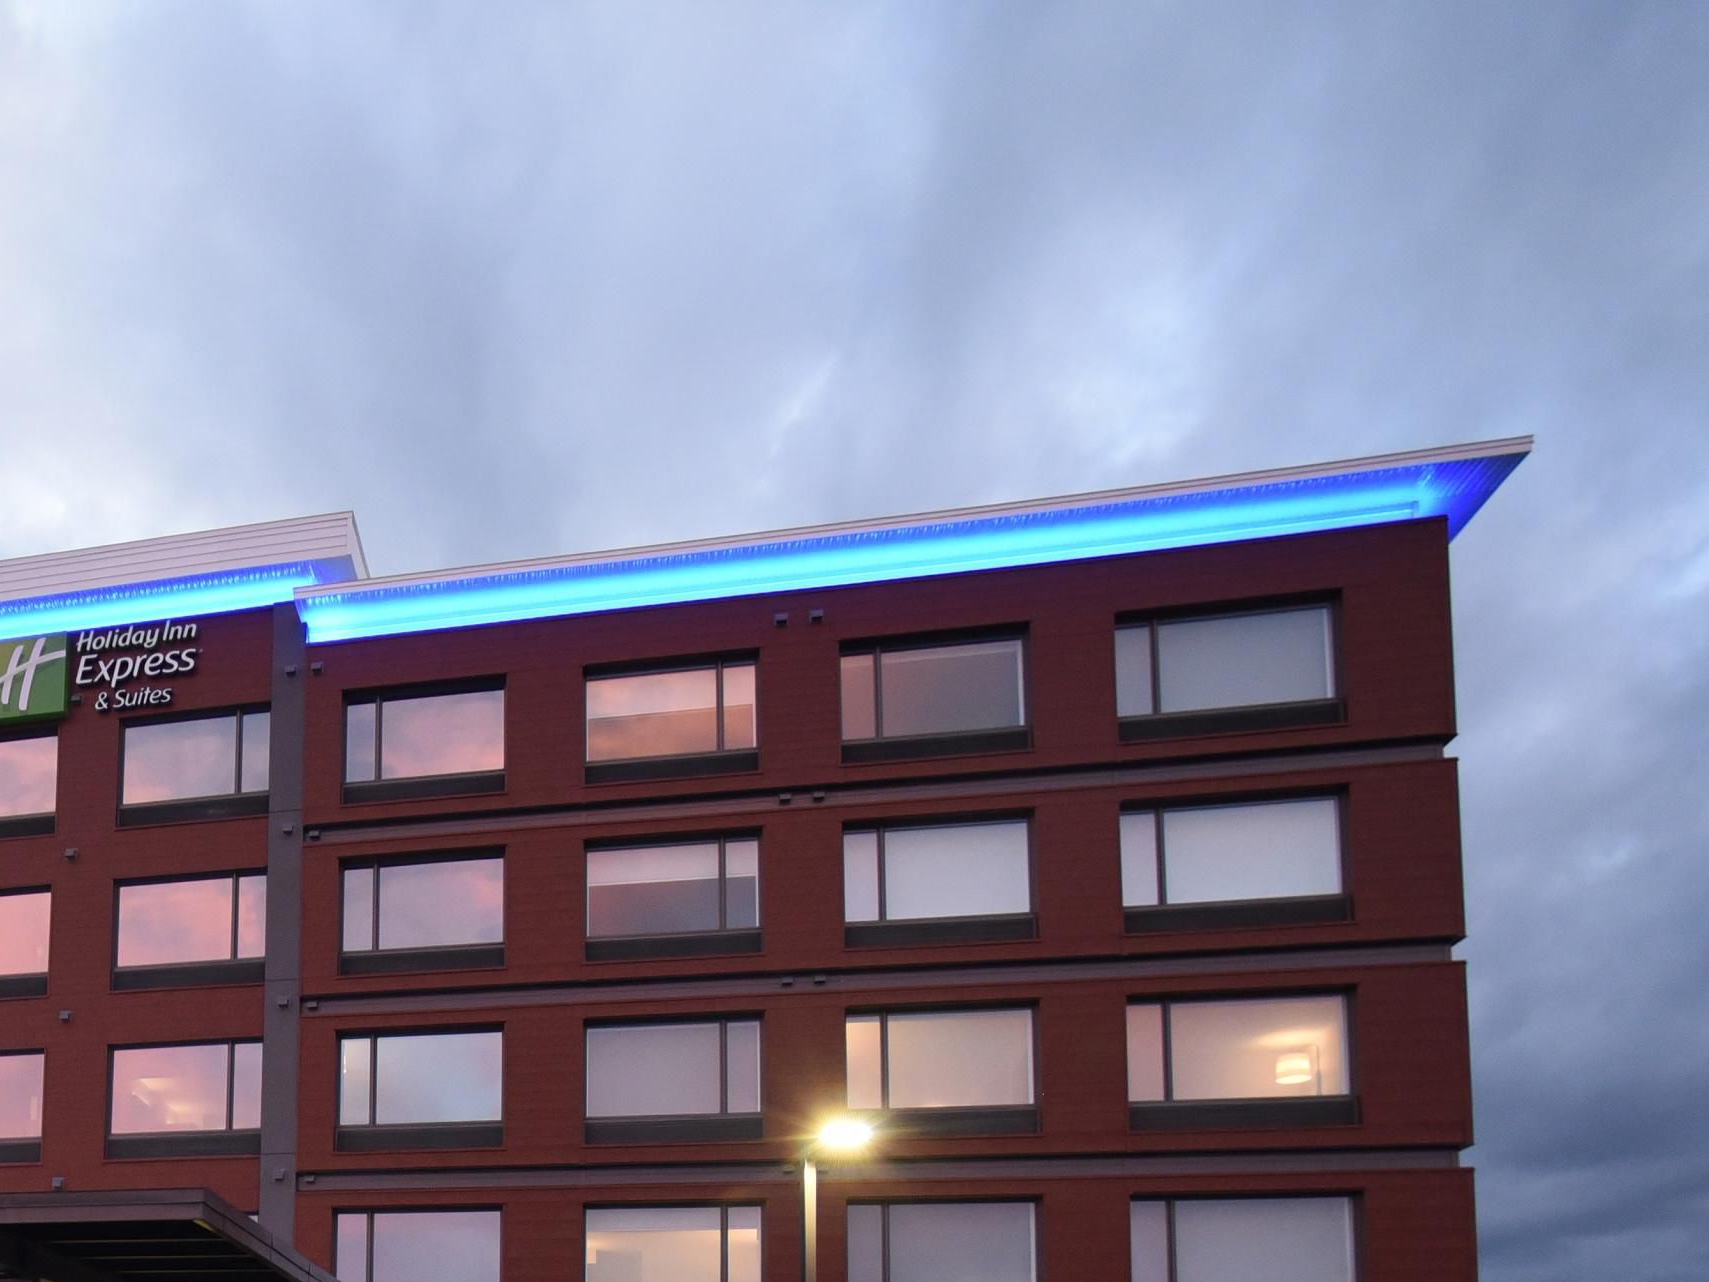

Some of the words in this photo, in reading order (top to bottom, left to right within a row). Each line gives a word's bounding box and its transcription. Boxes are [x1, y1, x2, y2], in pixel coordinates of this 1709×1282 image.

[76, 625, 160, 652] Holiday
[162, 619, 197, 642] Inn
[75, 648, 197, 688] Express
[94, 691, 109, 710] &
[112, 686, 172, 708] Suites
